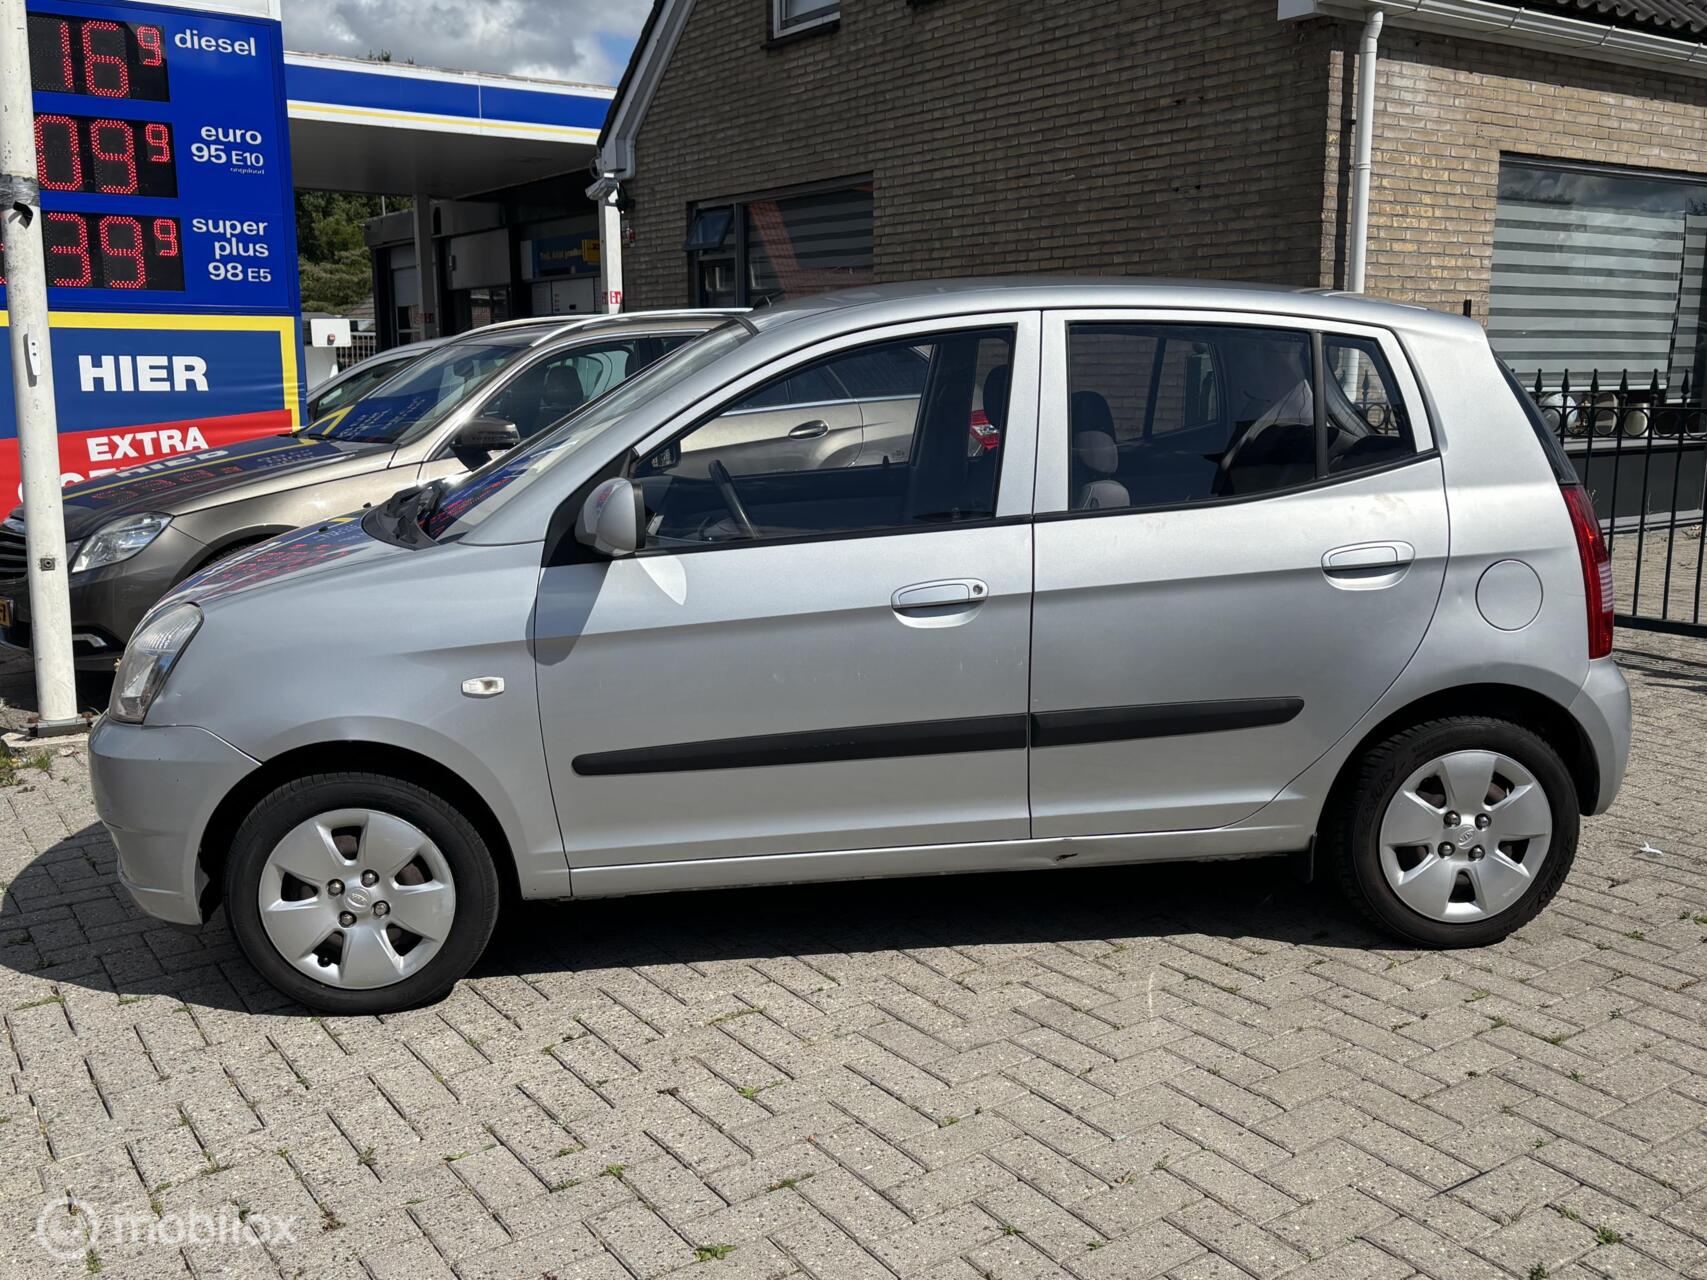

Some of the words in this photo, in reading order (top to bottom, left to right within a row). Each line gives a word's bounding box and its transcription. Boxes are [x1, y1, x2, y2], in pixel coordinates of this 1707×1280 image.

[174, 29, 256, 56] diesel
[200, 126, 262, 145] euro
[190, 143, 227, 164] 95
[231, 151, 264, 167] E10
[192, 218, 268, 239] super
[214, 237, 269, 259] plus
[207, 262, 244, 281] 98
[247, 268, 272, 282] E5
[78, 355, 209, 391] HIER
[86, 426, 209, 462] EXTRA
